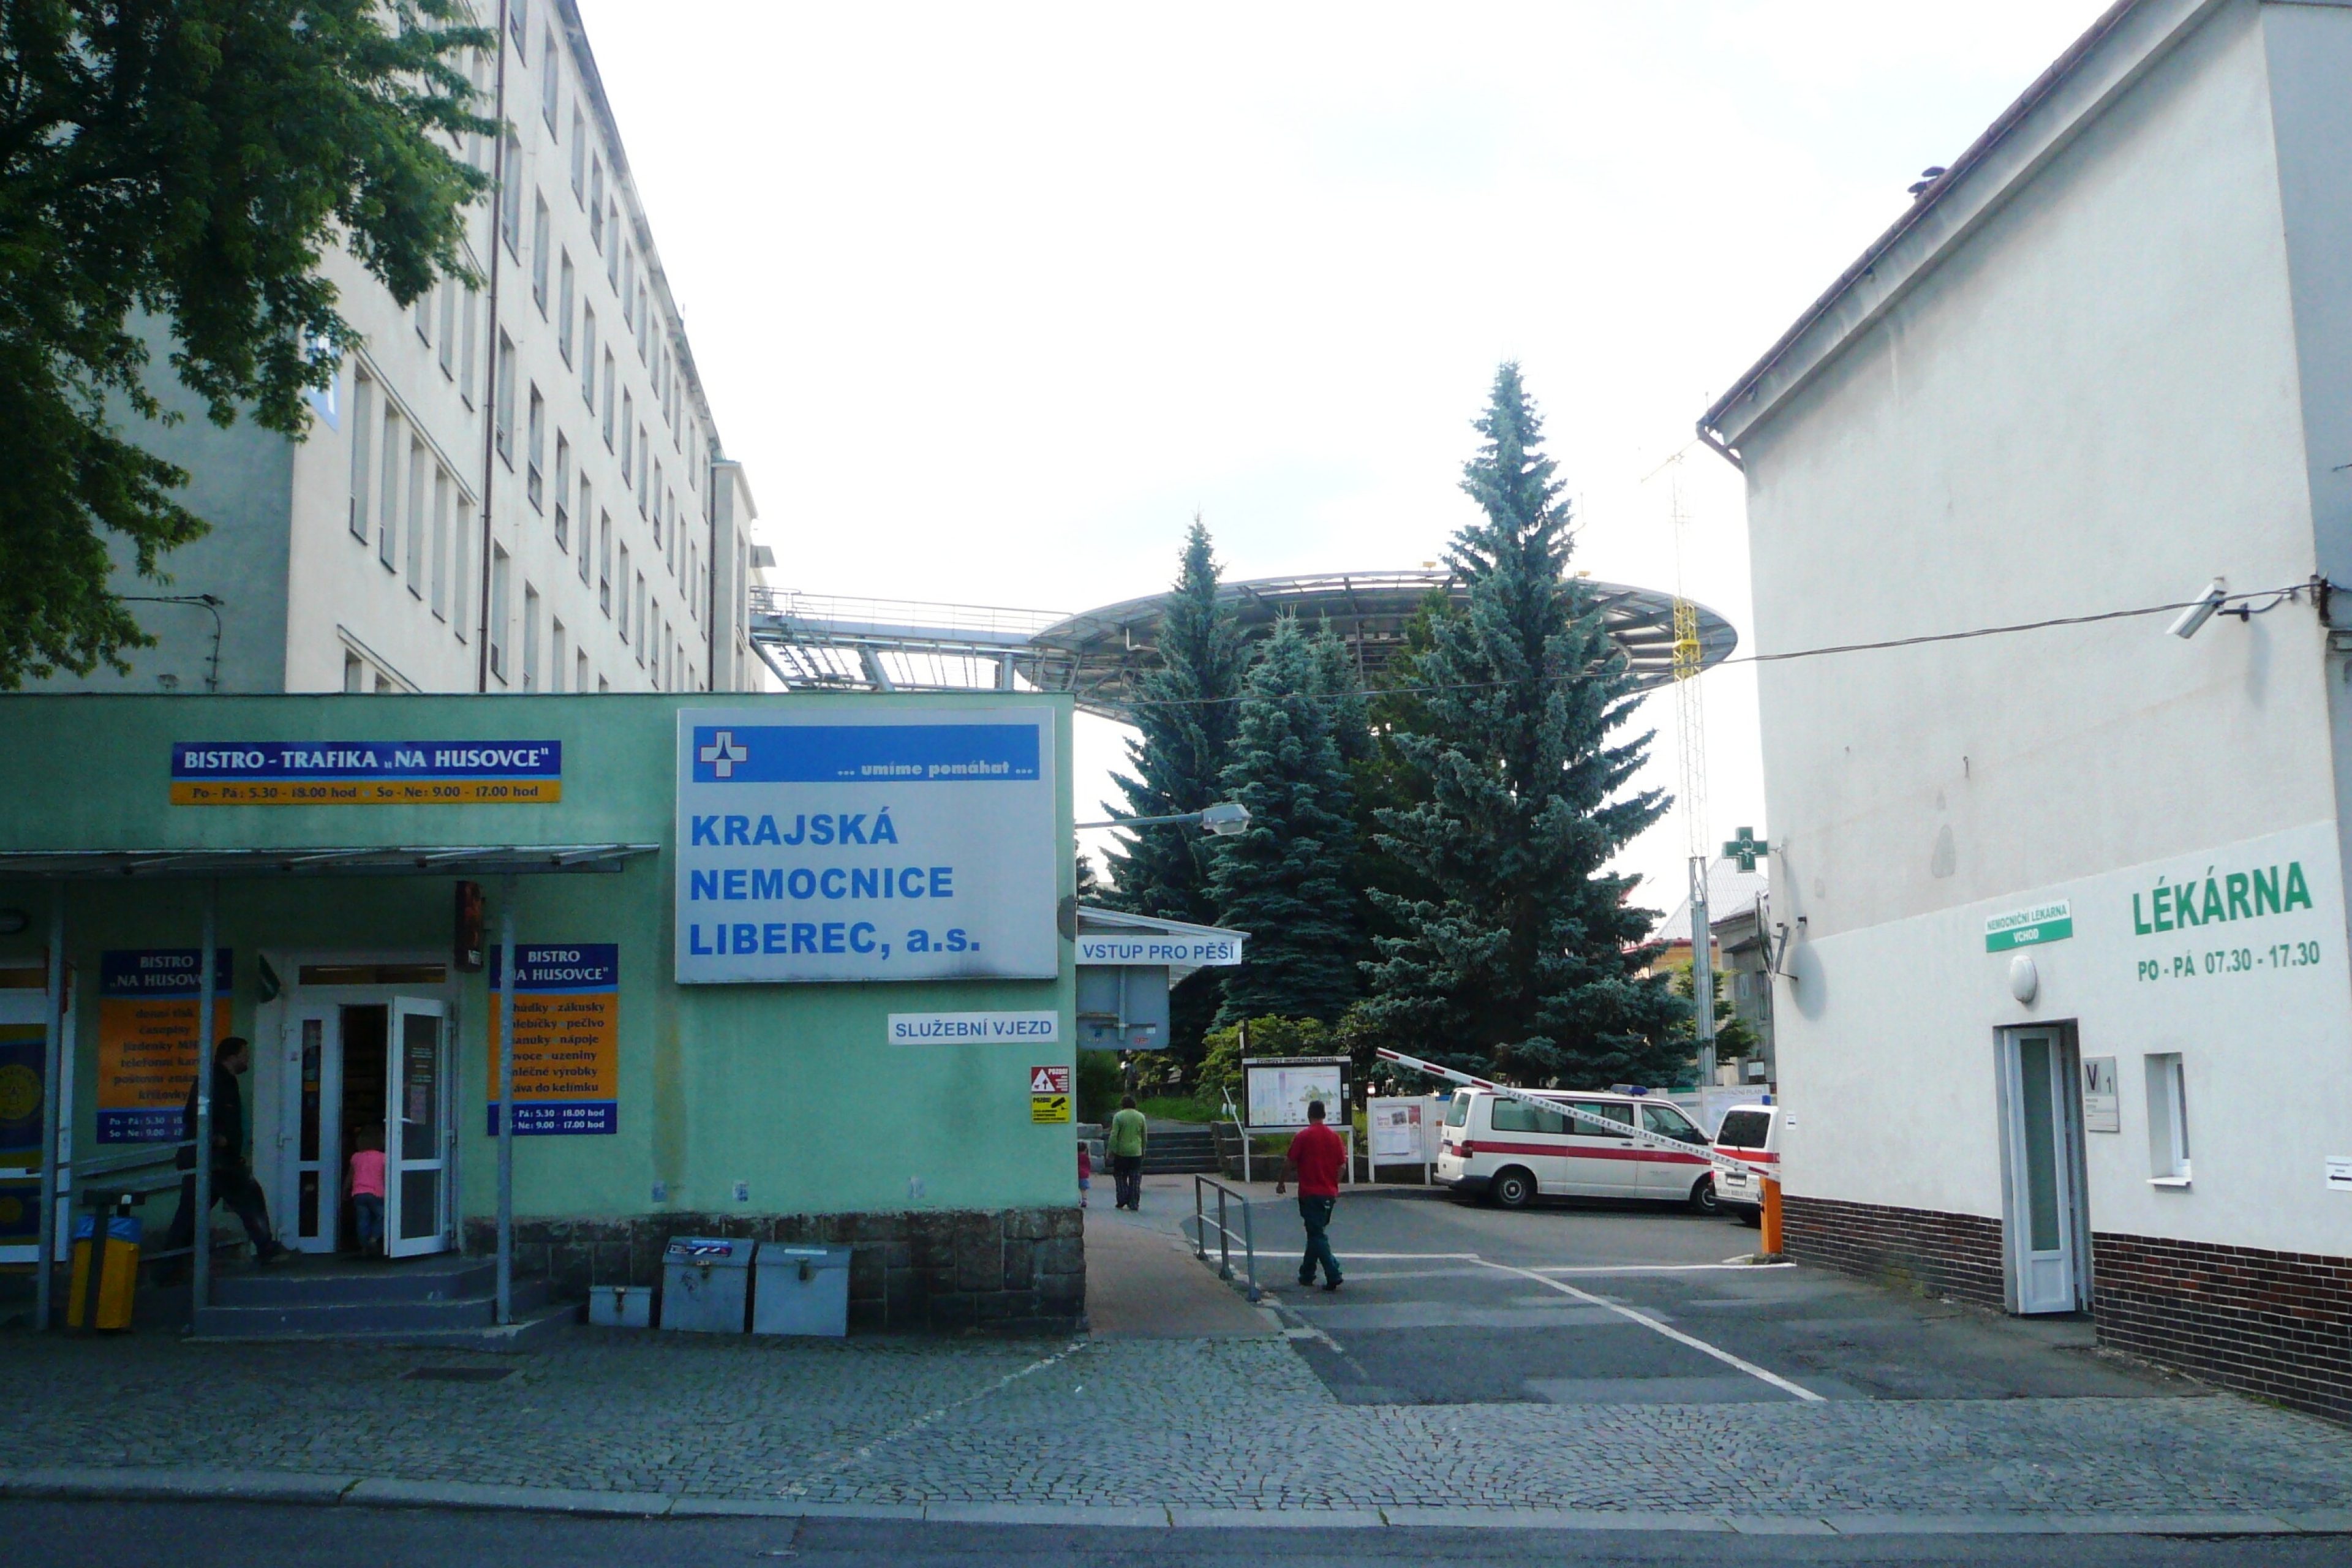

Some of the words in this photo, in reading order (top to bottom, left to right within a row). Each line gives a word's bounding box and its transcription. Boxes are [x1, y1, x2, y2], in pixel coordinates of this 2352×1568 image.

[184, 751, 265, 768] BISTRO
[281, 750, 378, 768] TRAFIKA
[861, 761, 922, 776] umíme
[929, 760, 1010, 778] pomáhat
[192, 787, 209, 797] Po
[249, 787, 277, 797] 5.30
[292, 787, 326, 797] 18.00
[331, 787, 356, 797] hod
[377, 787, 393, 797] So
[432, 786, 460, 797] 9.00
[475, 786, 508, 796] 17.00
[513, 786, 538, 796] hod
[691, 806, 899, 846] KRAJSKÁ
[690, 867, 954, 900] NEMOCNICE
[2133, 861, 2313, 936] LÉKÁRNA
[690, 922, 891, 960] LIBEREC,
[907, 927, 980, 954] a.s.
[2013, 928, 2040, 943] VCHOD
[527, 951, 581, 963] BISTRO
[1083, 944, 1143, 959] VSTUP
[1149, 944, 1188, 960] PRO
[1193, 941, 1234, 960] PĚŠÍ
[140, 956, 194, 968] BISTRO
[2138, 960, 2159, 981] PO
[2173, 950, 2195, 978] PÁ
[2205, 948, 2252, 974] 07.30
[2269, 941, 2320, 969] 17.30
[558, 1001, 605, 1014] zákusky
[567, 1017, 605, 1030] pečivo
[895, 1018, 988, 1038] SLUŽEBNÍ
[993, 1020, 1052, 1036] VJEZD
[513, 1035, 551, 1046] anuky
[560, 1033, 599, 1046] nápoje
[551, 1050, 597, 1062] uzeniny
[552, 1065, 597, 1078] výrobky
[2086, 1064, 2097, 1090] V
[2106, 1076, 2111, 1093] 1
[514, 1082, 532, 1092] áva
[535, 1082, 549, 1092] do
[552, 1081, 598, 1092] kelímku
[535, 1109, 555, 1118] 5.30
[562, 1109, 586, 1118] 18.00
[587, 1109, 605, 1118] hod
[536, 1121, 555, 1129] 9.00
[564, 1120, 585, 1129] 17.00
[587, 1120, 605, 1129] hod
